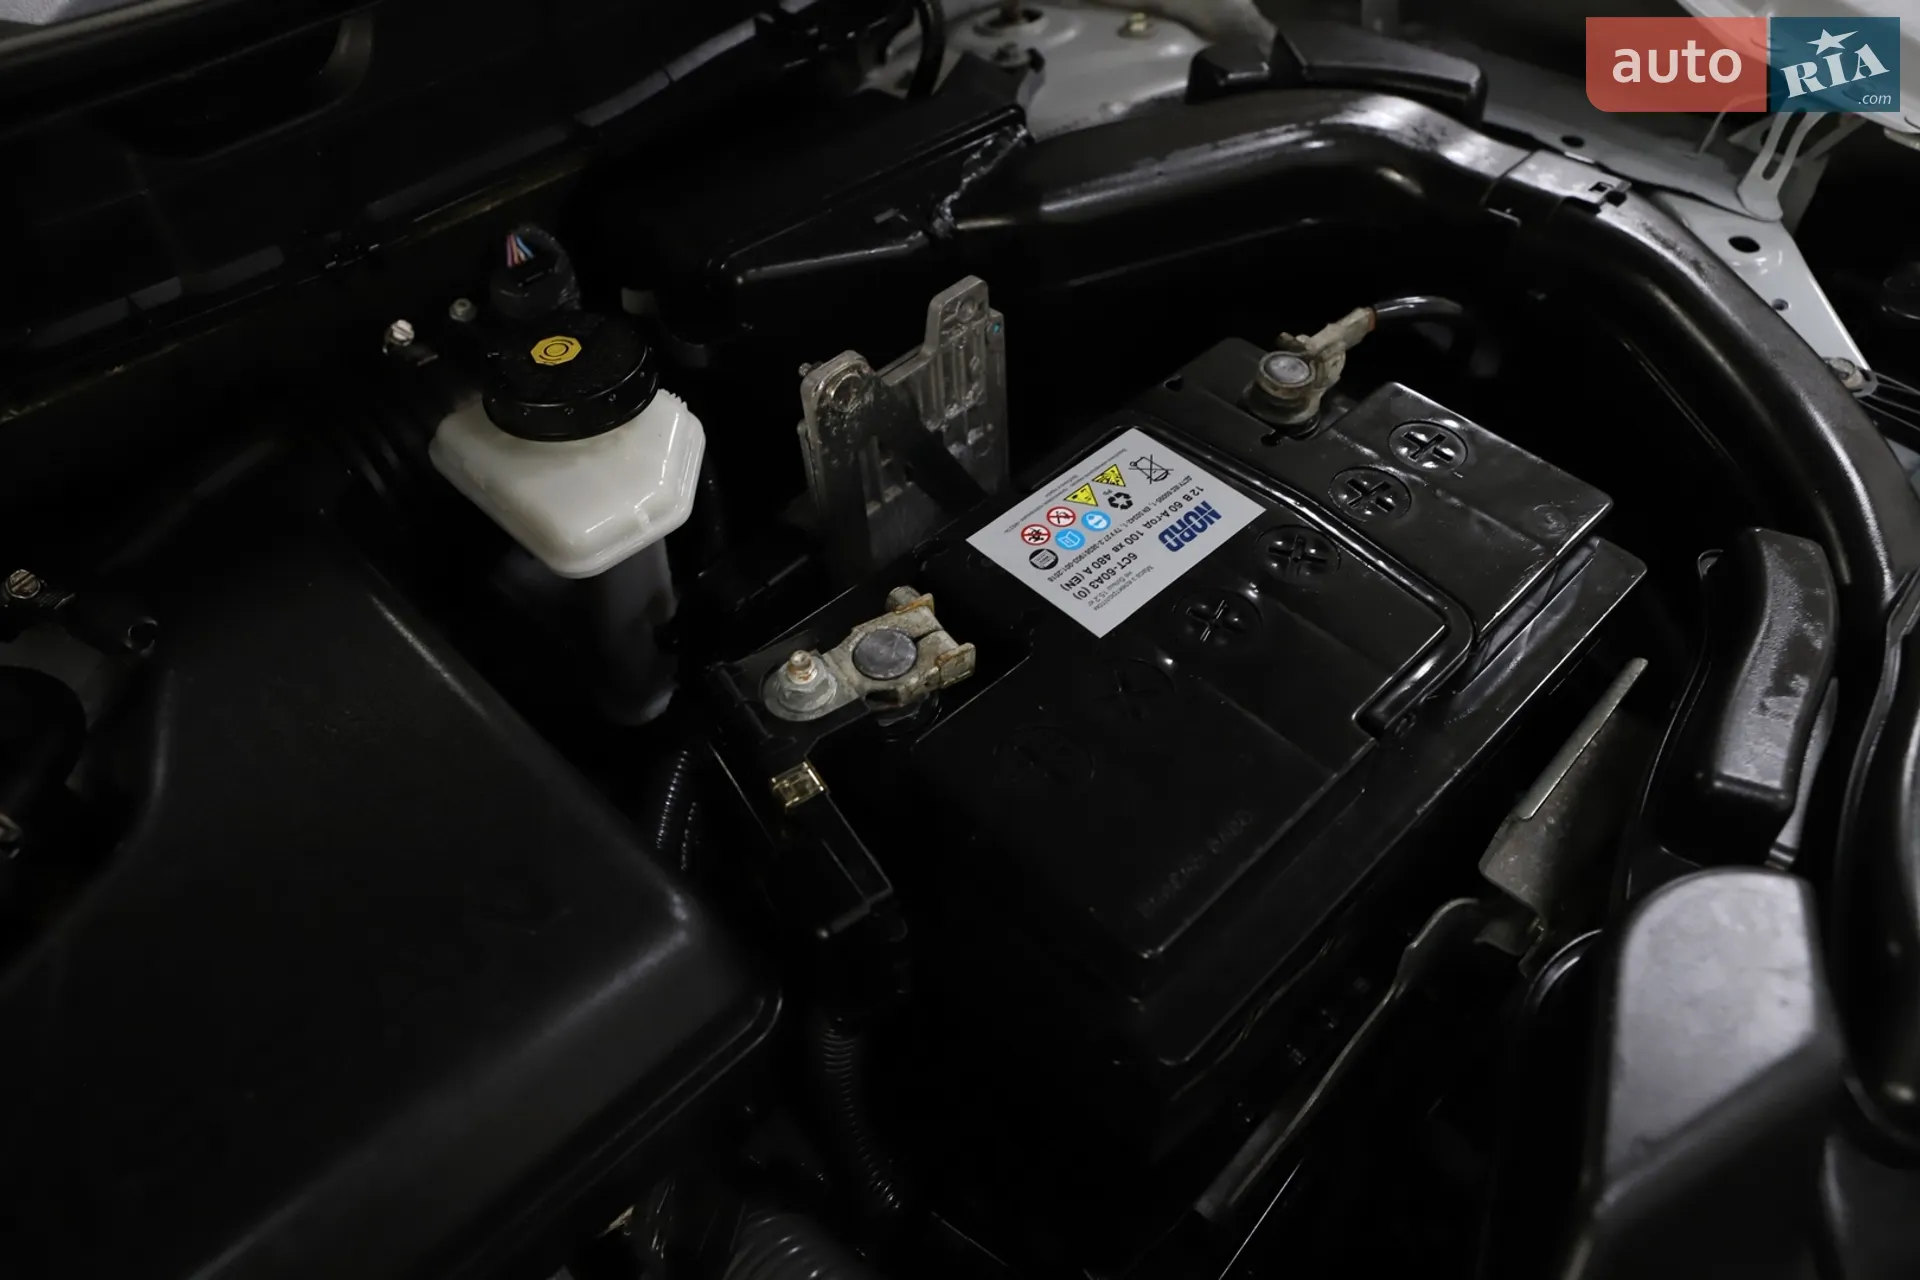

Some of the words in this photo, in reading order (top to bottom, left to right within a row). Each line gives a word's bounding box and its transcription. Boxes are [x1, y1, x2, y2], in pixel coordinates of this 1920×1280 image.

[1190, 485, 1204, 497] 12
[1168, 501, 1183, 513] 60
[1158, 500, 1222, 552] NORD
[1124, 529, 1145, 545] 100
[1091, 552, 1113, 569] 480
[1059, 571, 1086, 592] (EN)
